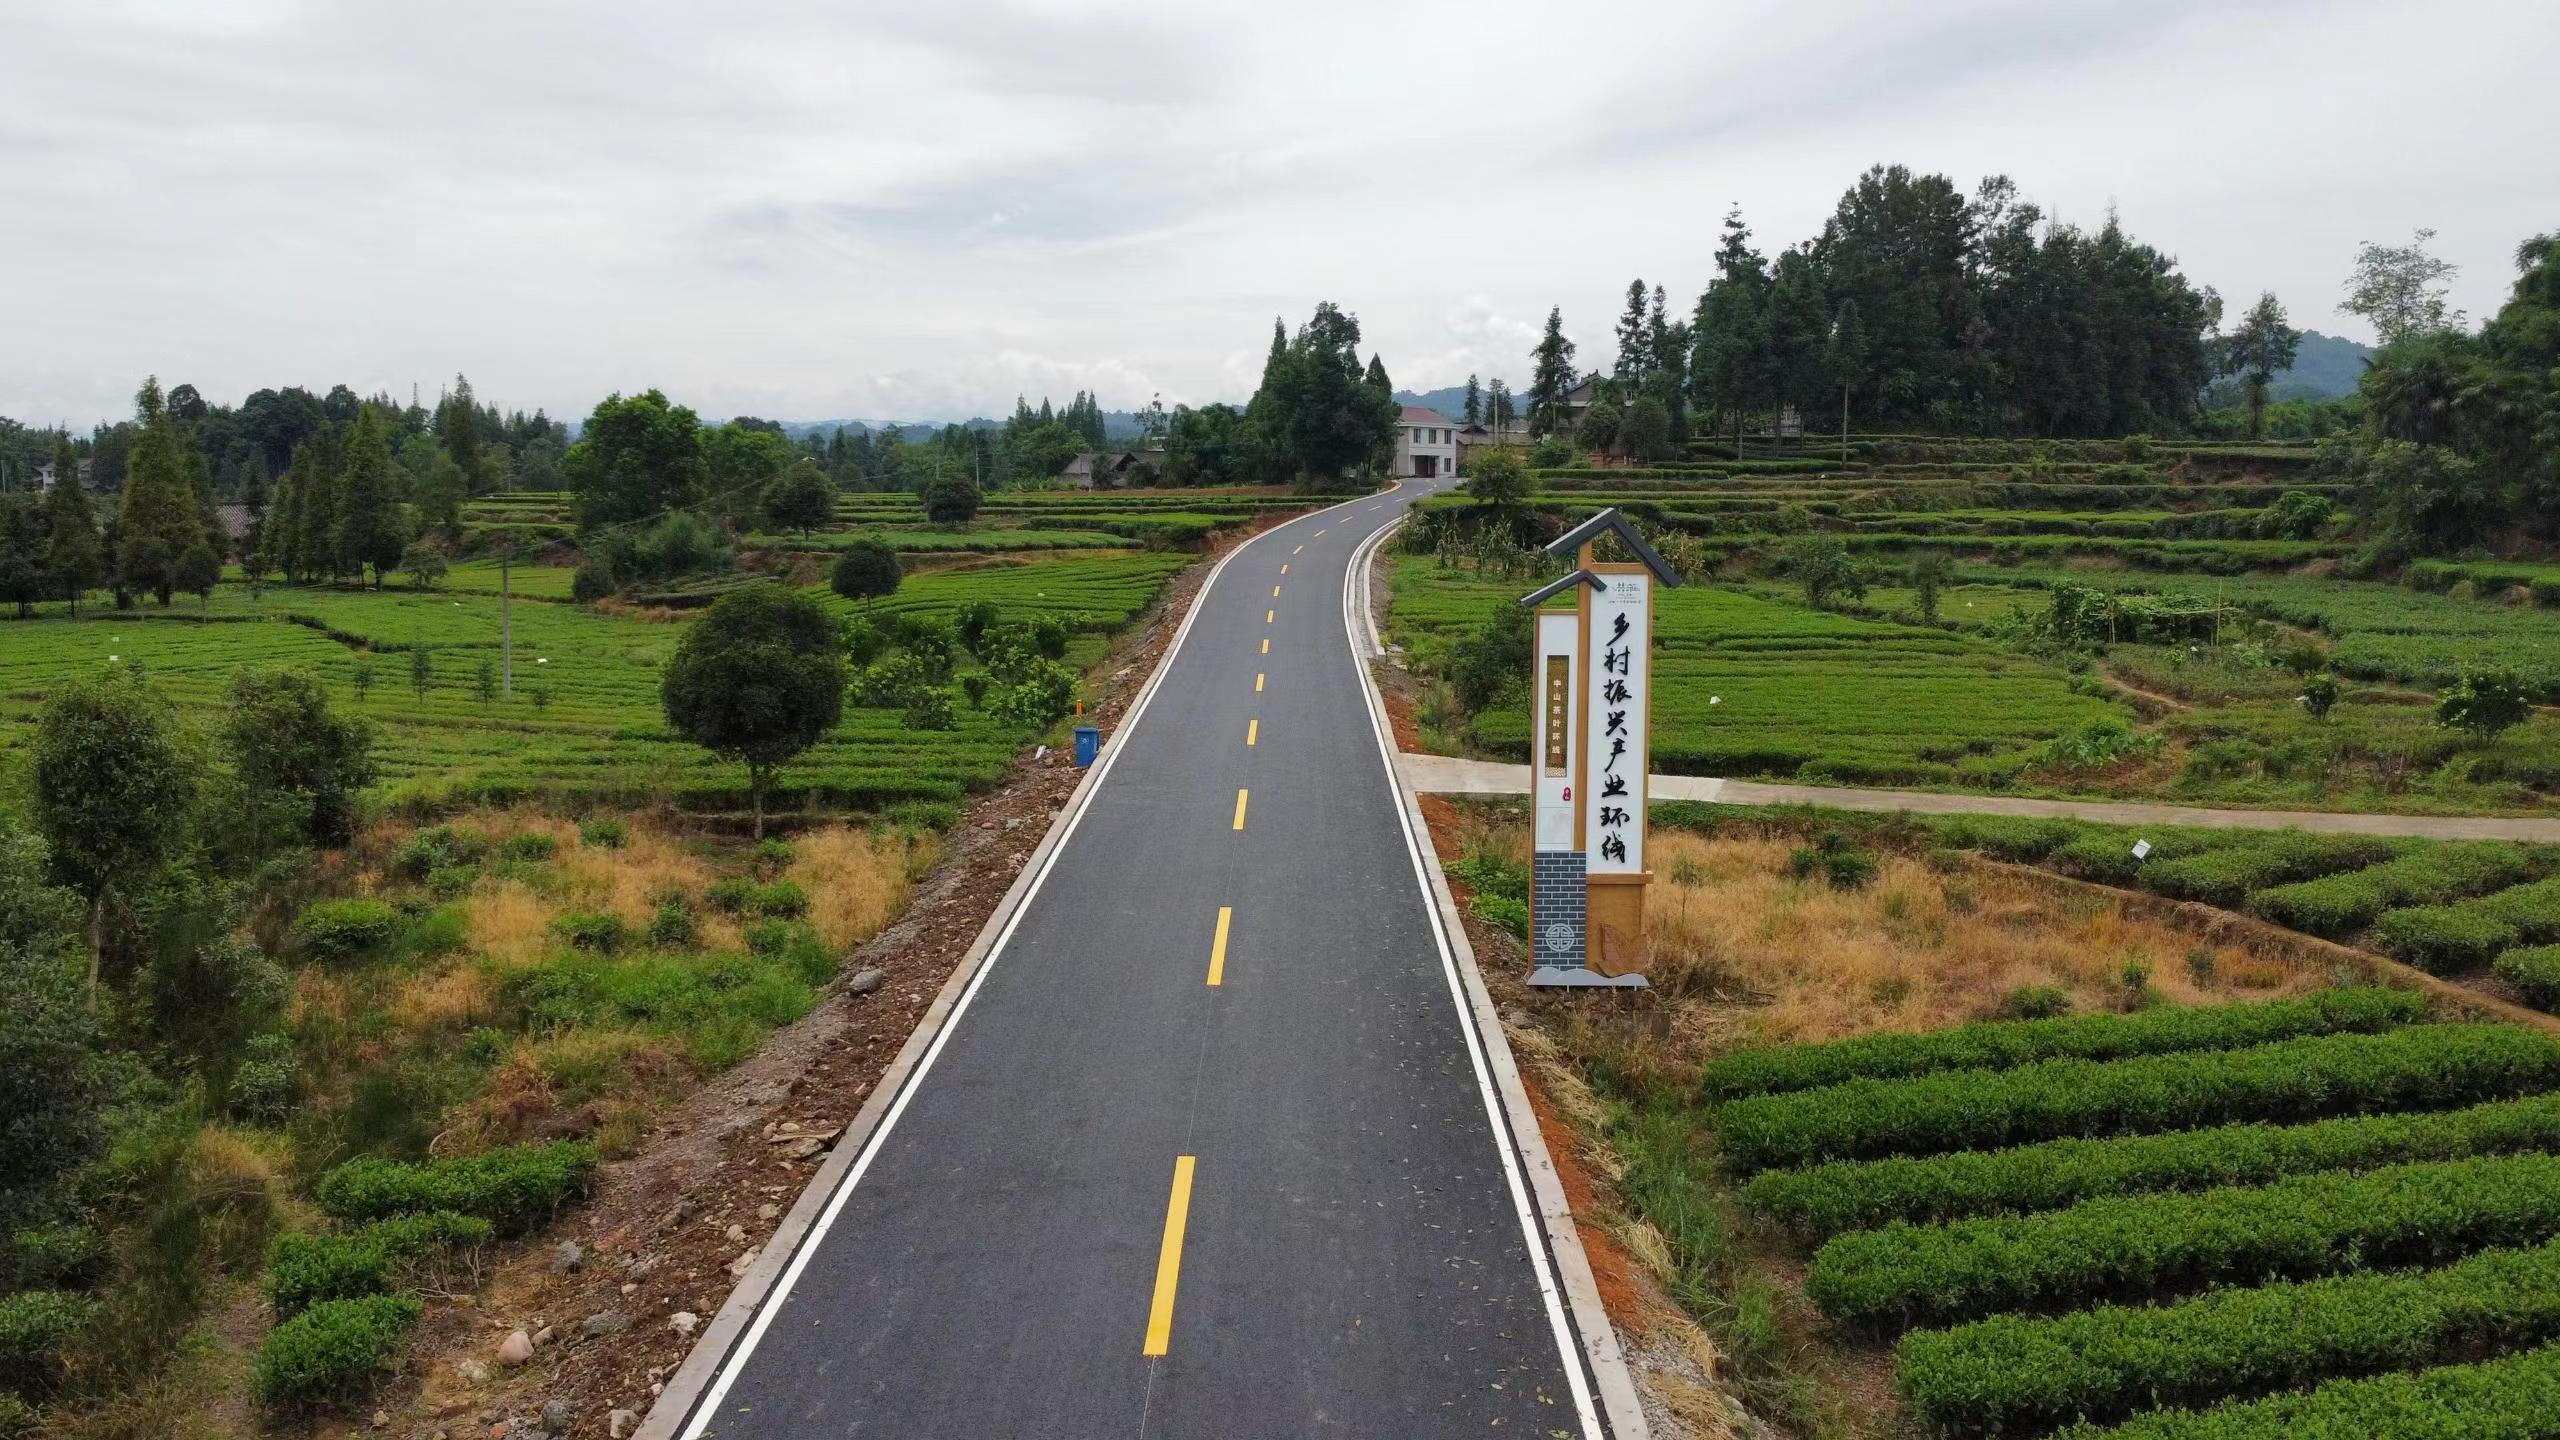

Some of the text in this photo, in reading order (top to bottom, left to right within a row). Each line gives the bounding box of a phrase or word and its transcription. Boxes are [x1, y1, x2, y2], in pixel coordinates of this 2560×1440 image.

[1600, 612, 1632, 863] 乡村振兴产业环线
